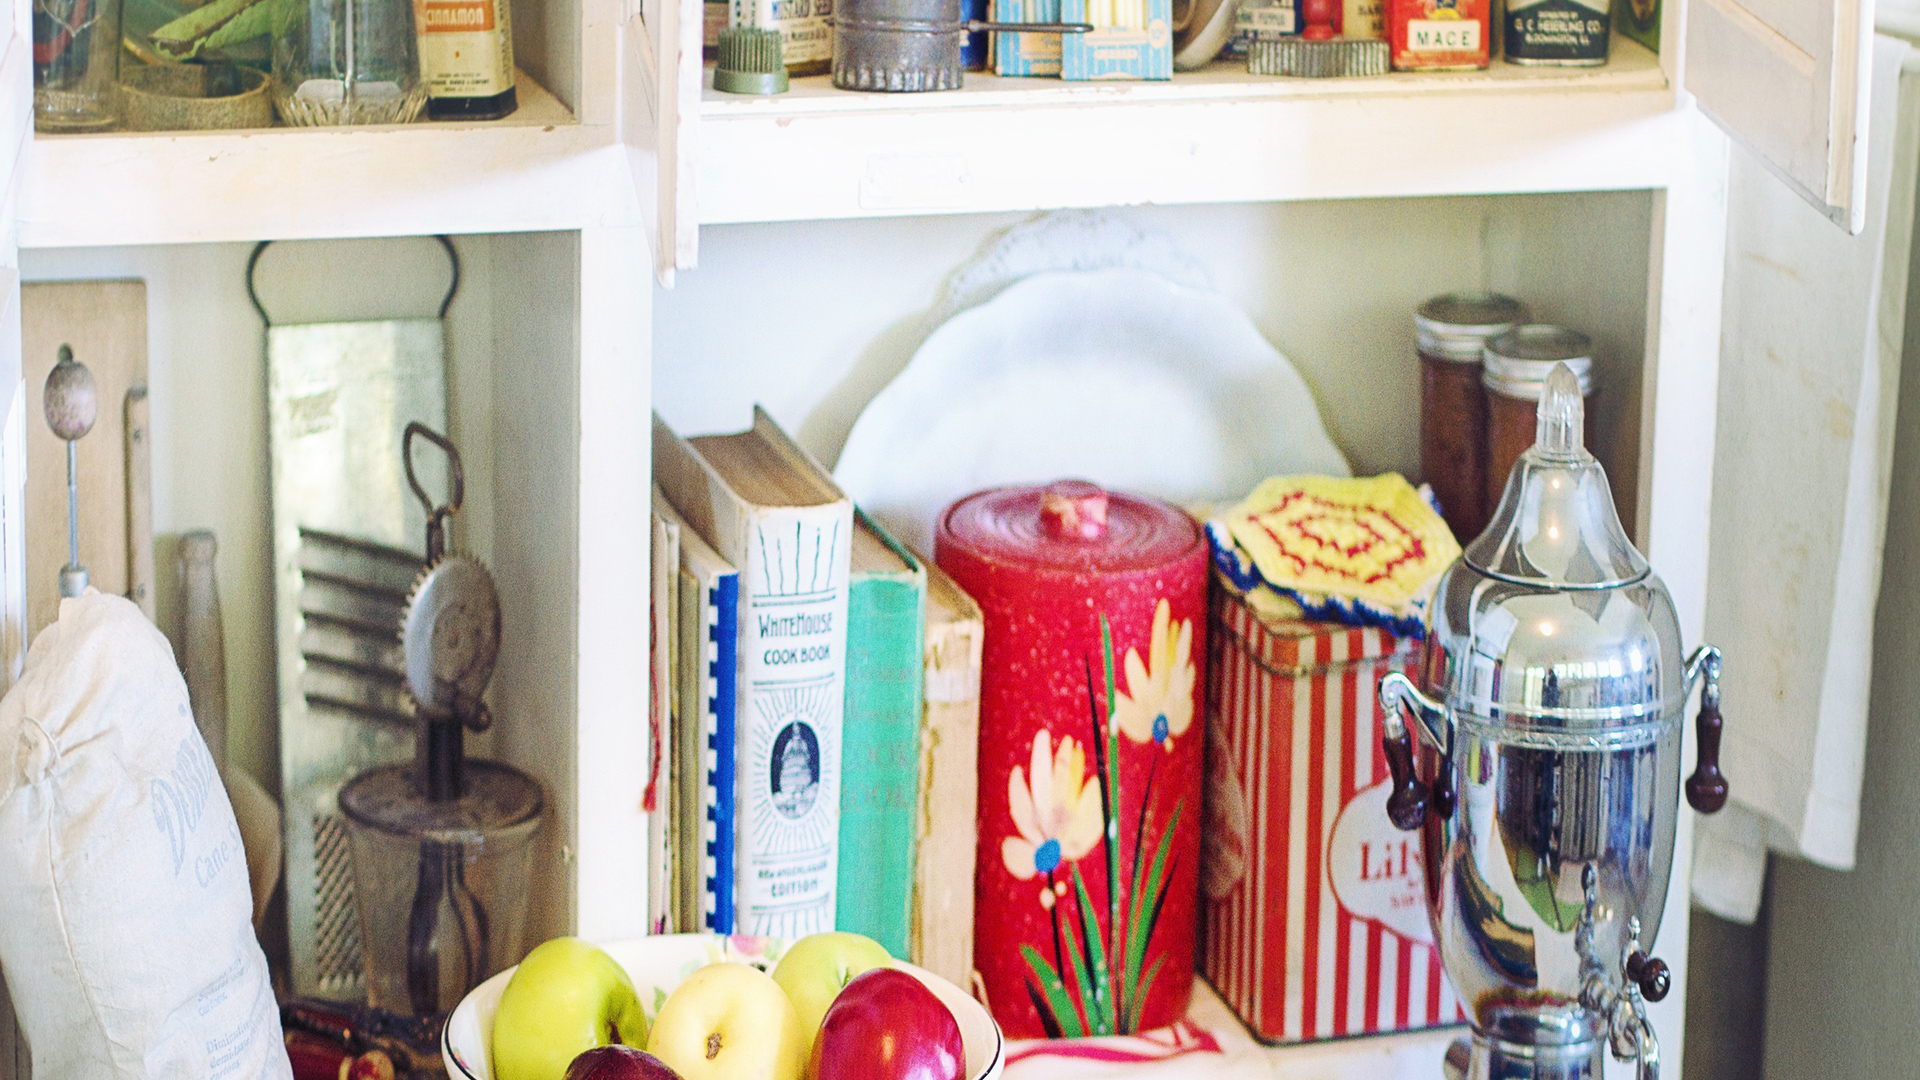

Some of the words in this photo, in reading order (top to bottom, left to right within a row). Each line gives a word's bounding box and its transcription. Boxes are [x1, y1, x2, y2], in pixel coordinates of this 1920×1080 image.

[426, 7, 485, 26] CINNAMON
[1416, 30, 1471, 46] MACE
[763, 647, 798, 666] COOK
[800, 643, 831, 664] BOOK
[194, 840, 230, 889] Cane
[770, 877, 818, 898] EDITION
